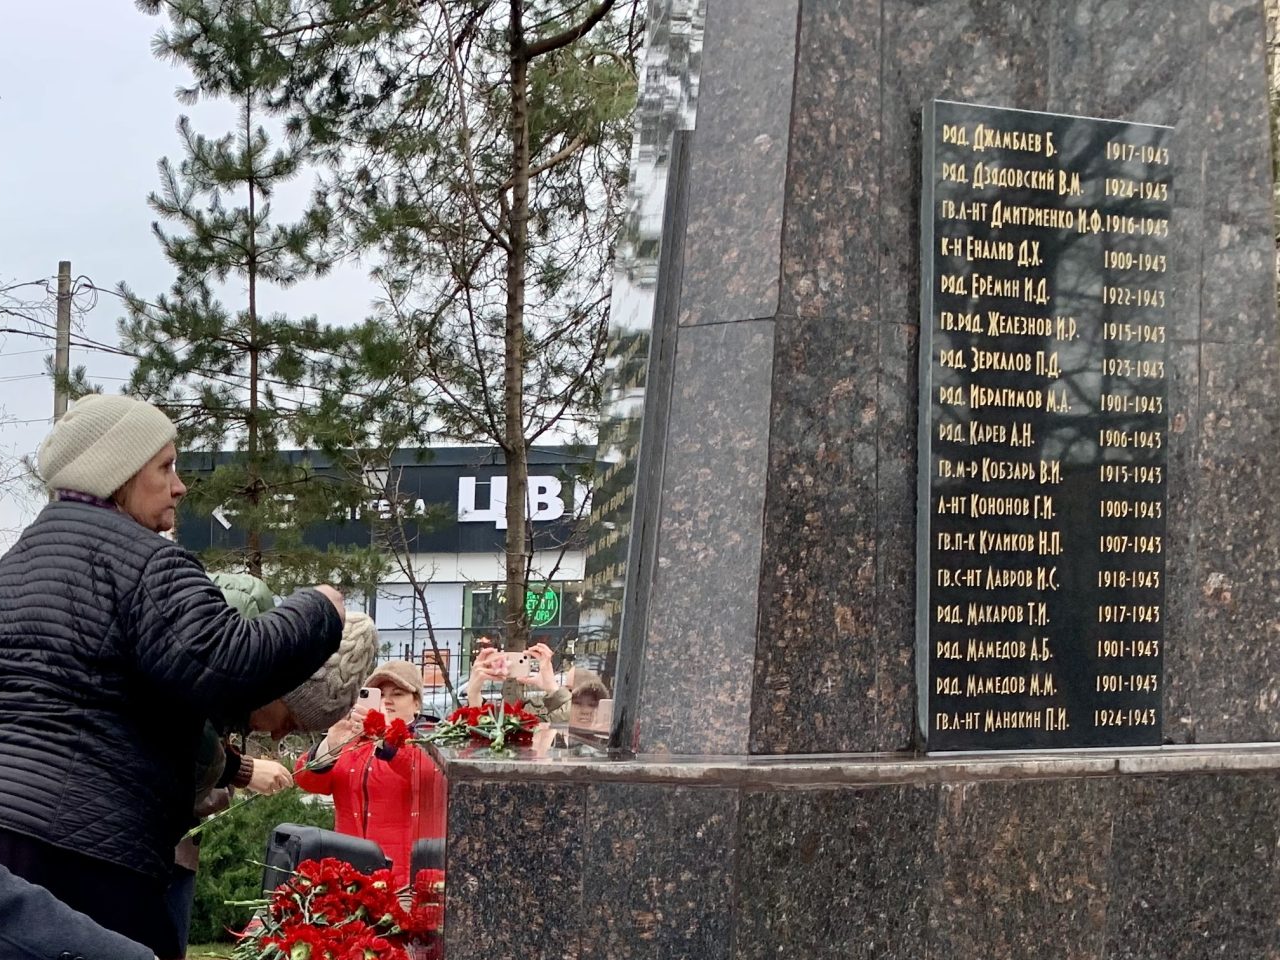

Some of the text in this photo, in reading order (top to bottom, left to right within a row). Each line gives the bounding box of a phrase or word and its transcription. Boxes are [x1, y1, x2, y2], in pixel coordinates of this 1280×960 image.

[943, 122, 1169, 166] РЯД. ДЖАМБАЕВ Б. 1917-1943
[943, 160, 1168, 202] РЯД. ДЗЯДОВСКИЙ В.М. 1924-1943
[942, 198, 1168, 238] ГВ.Л-НТ ДМИТРИЕНКО И.Ф. 1916-1943
[942, 234, 1167, 274] К-Н ЕНАЛИВ Д.Х. 1909-1943
[941, 272, 1165, 309] РЯД. ЕРЕМИН И.Д. 1922-1943
[941, 310, 1166, 344] ГВ.РЯД. ЖЕЛЕЗНОВ И.Р. 1915-1943
[940, 346, 1165, 380] РЯД. ЗЕРКАЛОВ П.Д. 1923-1943
[940, 383, 1163, 414] РЯД. ИБРАГИМОВ М.А. 1901-1943
[939, 419, 1161, 449] РЯД. КАРЕВ А.Н. 1906-1943
[939, 456, 1162, 484] ГВ.М-Р КОБЗАРЬ В.И. 1915-1943
[938, 492, 1162, 519] Л-НТ КОНОНОВ Г.И. 1909-1943
[938, 529, 1162, 555] ГВ.П-К КУЛИКОВ Н.П. 1907-1943
[938, 565, 1159, 590] ГВ.С-НТ ЛАВРОВ И.С. 1918-1943
[937, 601, 1160, 626] РЯД. МАКАРОВ Т.И. 1917-1943
[937, 637, 1159, 662] РЯД. МАМЕДОВ А.Б. 1901-1943
[937, 672, 1157, 697] РЯД. МАМЕДОВ М.М. 1901-1943
[936, 706, 1156, 732] ГВ.Л-НТ МАНЯКИН П.И. 1924-1943
